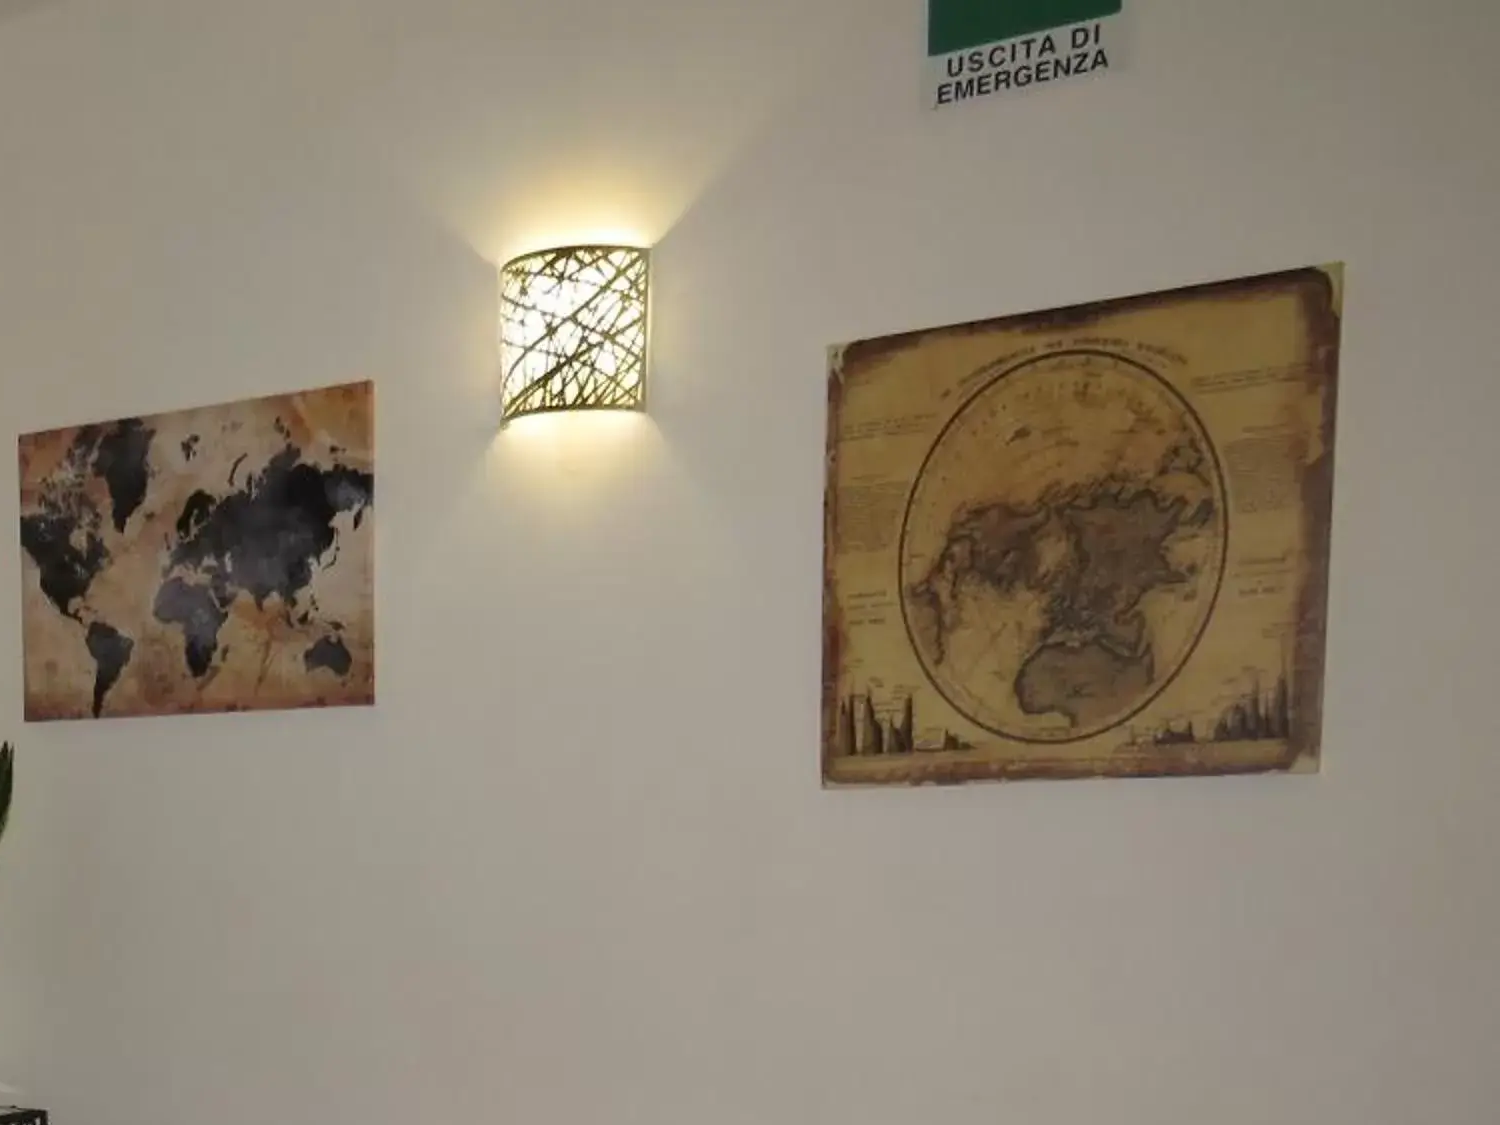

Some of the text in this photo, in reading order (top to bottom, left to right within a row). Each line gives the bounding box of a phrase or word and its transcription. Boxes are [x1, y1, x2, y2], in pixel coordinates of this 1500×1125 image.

[936, 48, 1109, 105] EMERGENZA
[947, 23, 1101, 78] USCITA DI
